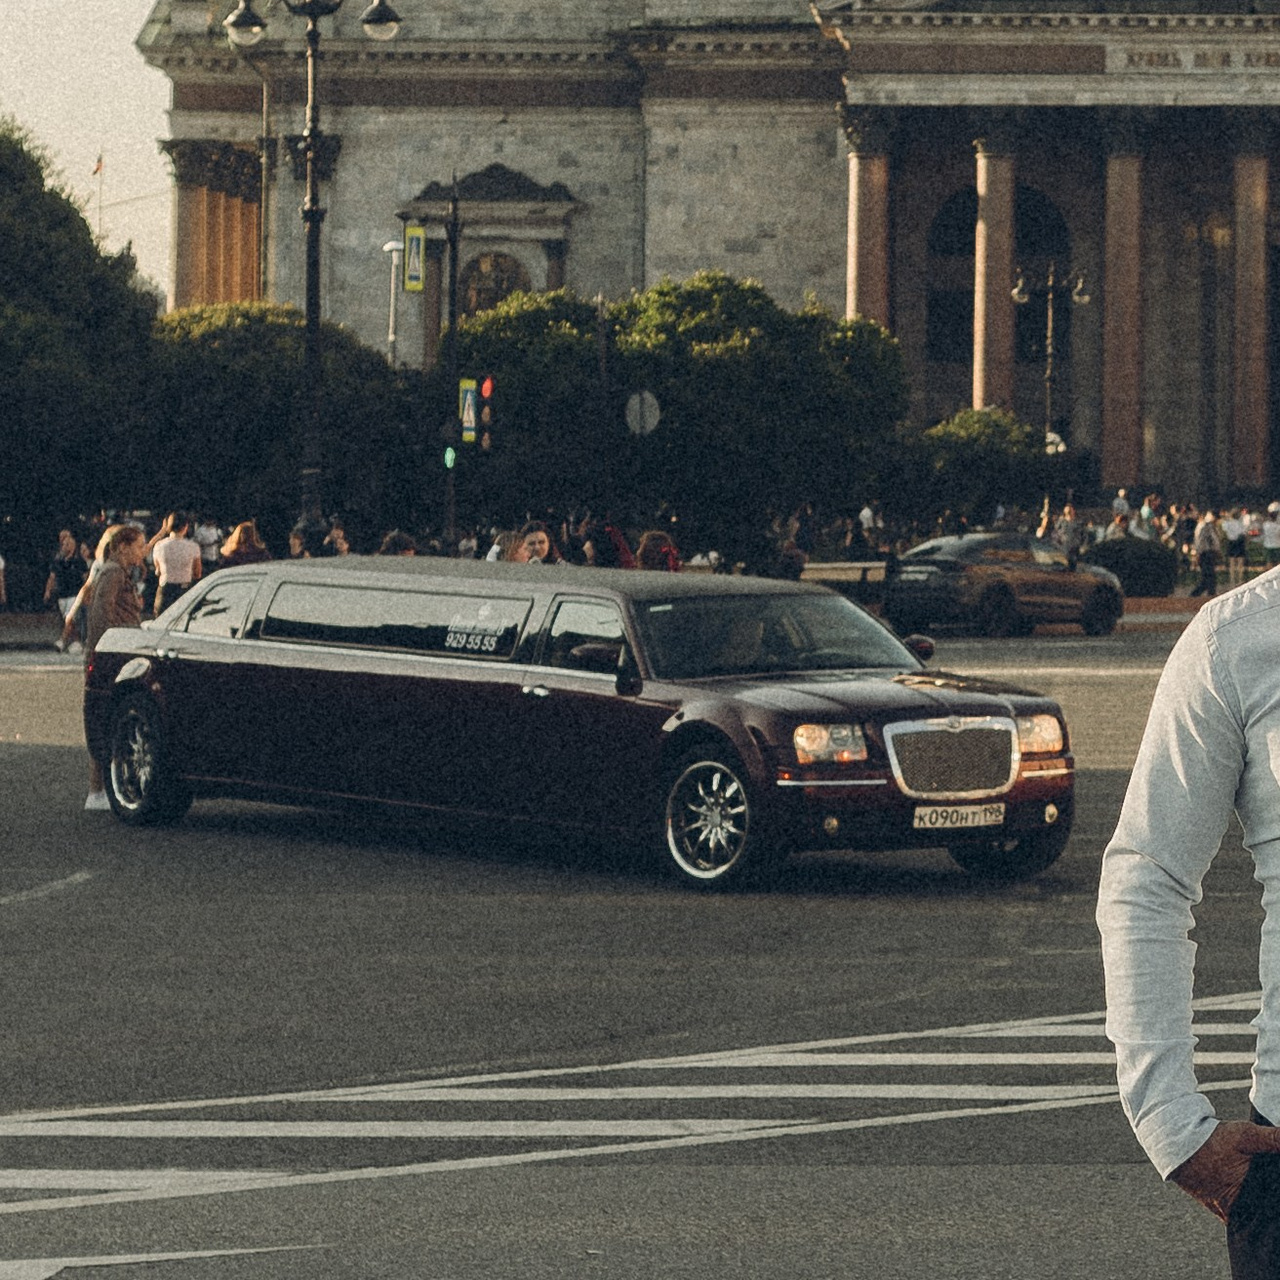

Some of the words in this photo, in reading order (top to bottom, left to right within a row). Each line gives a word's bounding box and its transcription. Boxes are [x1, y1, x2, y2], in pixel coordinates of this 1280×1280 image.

[445, 632, 467, 648] 929
[466, 635, 482, 650] 55
[481, 636, 497, 651] 55
